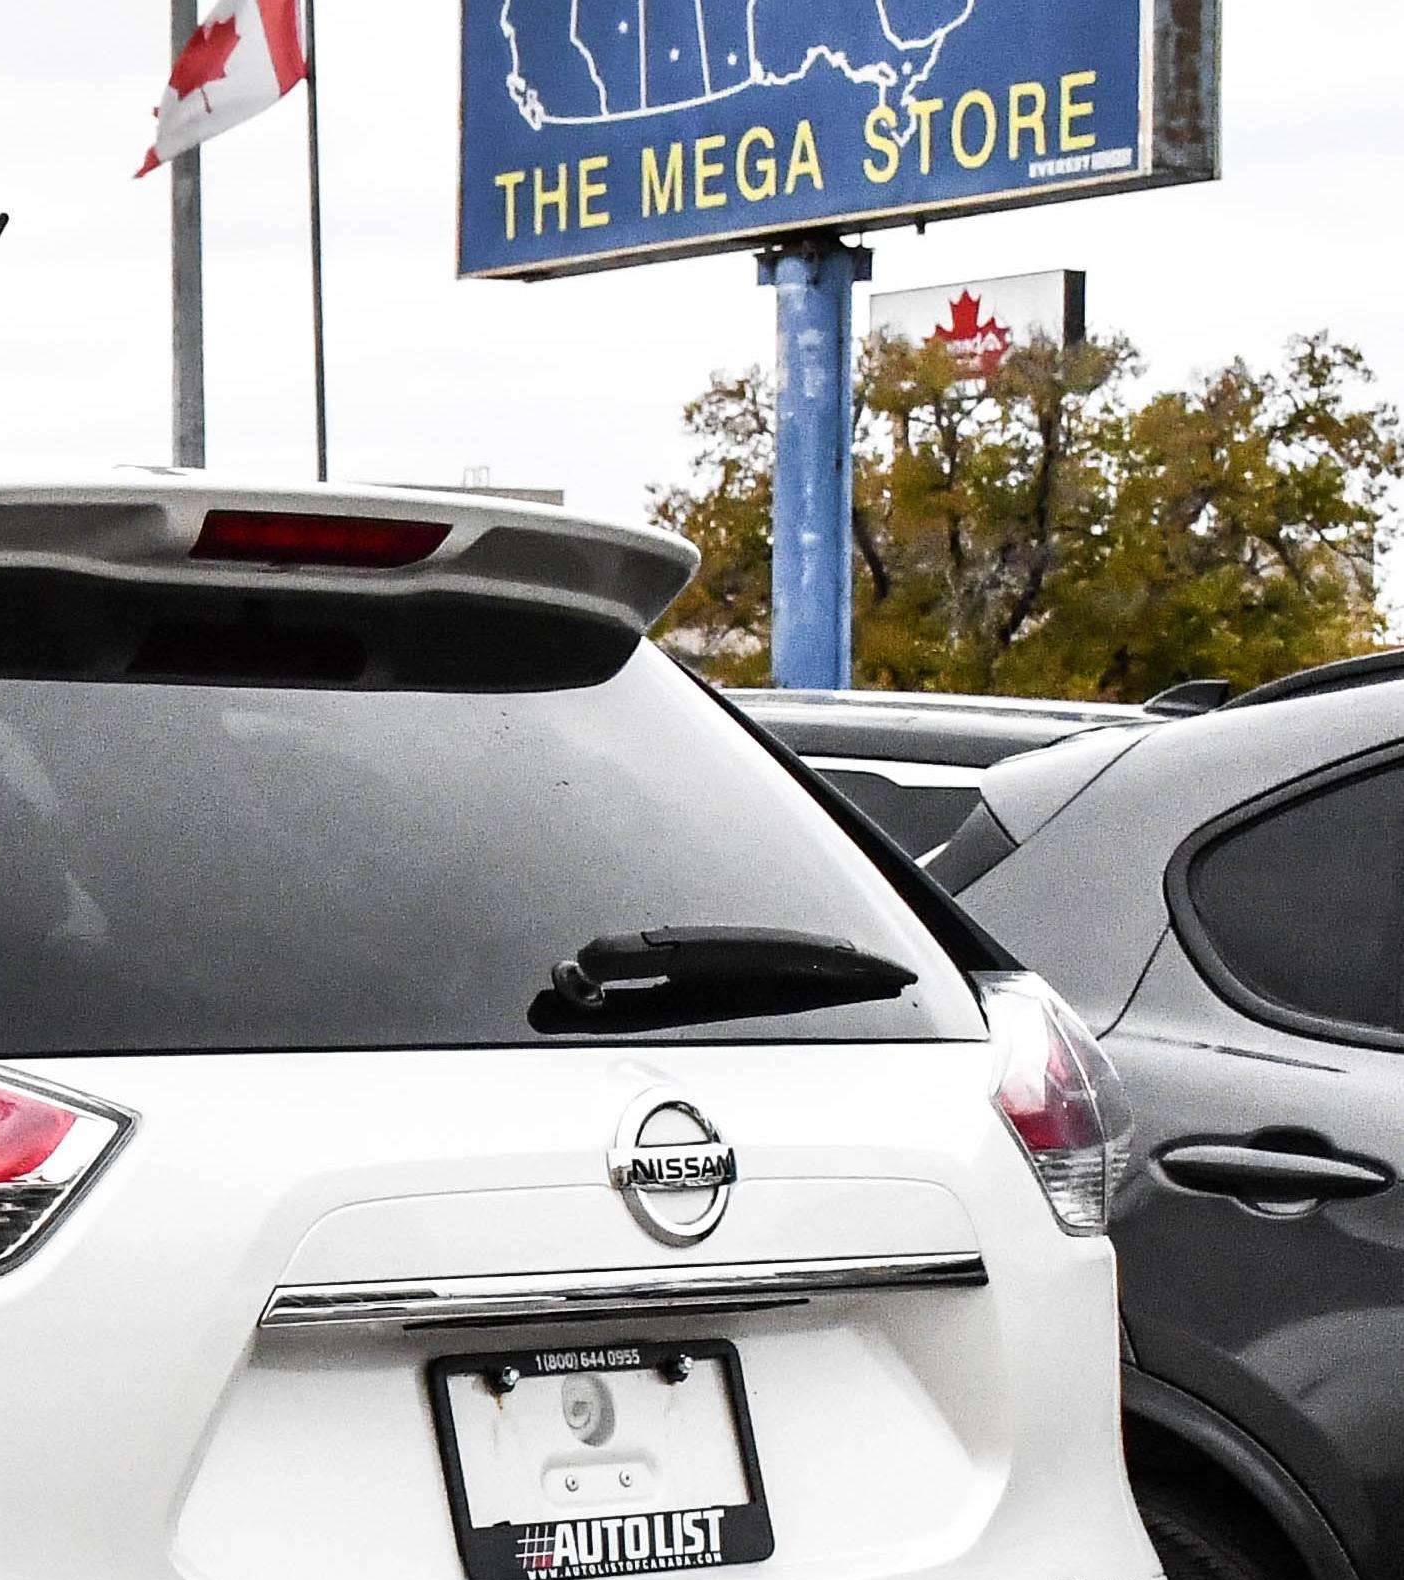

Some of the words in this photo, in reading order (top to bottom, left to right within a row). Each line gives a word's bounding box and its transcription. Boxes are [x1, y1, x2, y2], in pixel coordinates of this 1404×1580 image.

[494, 154, 611, 241] THE
[640, 119, 824, 218] MEGA
[862, 70, 1097, 183] STORE
[630, 1148, 737, 1183] NISSAN
[535, 1351, 578, 1372] 1(800)
[580, 1350, 606, 1368] 644
[607, 1348, 640, 1366] 0955
[526, 1552, 723, 1580] WWW.AUTOLISTOFCANADA.COM
